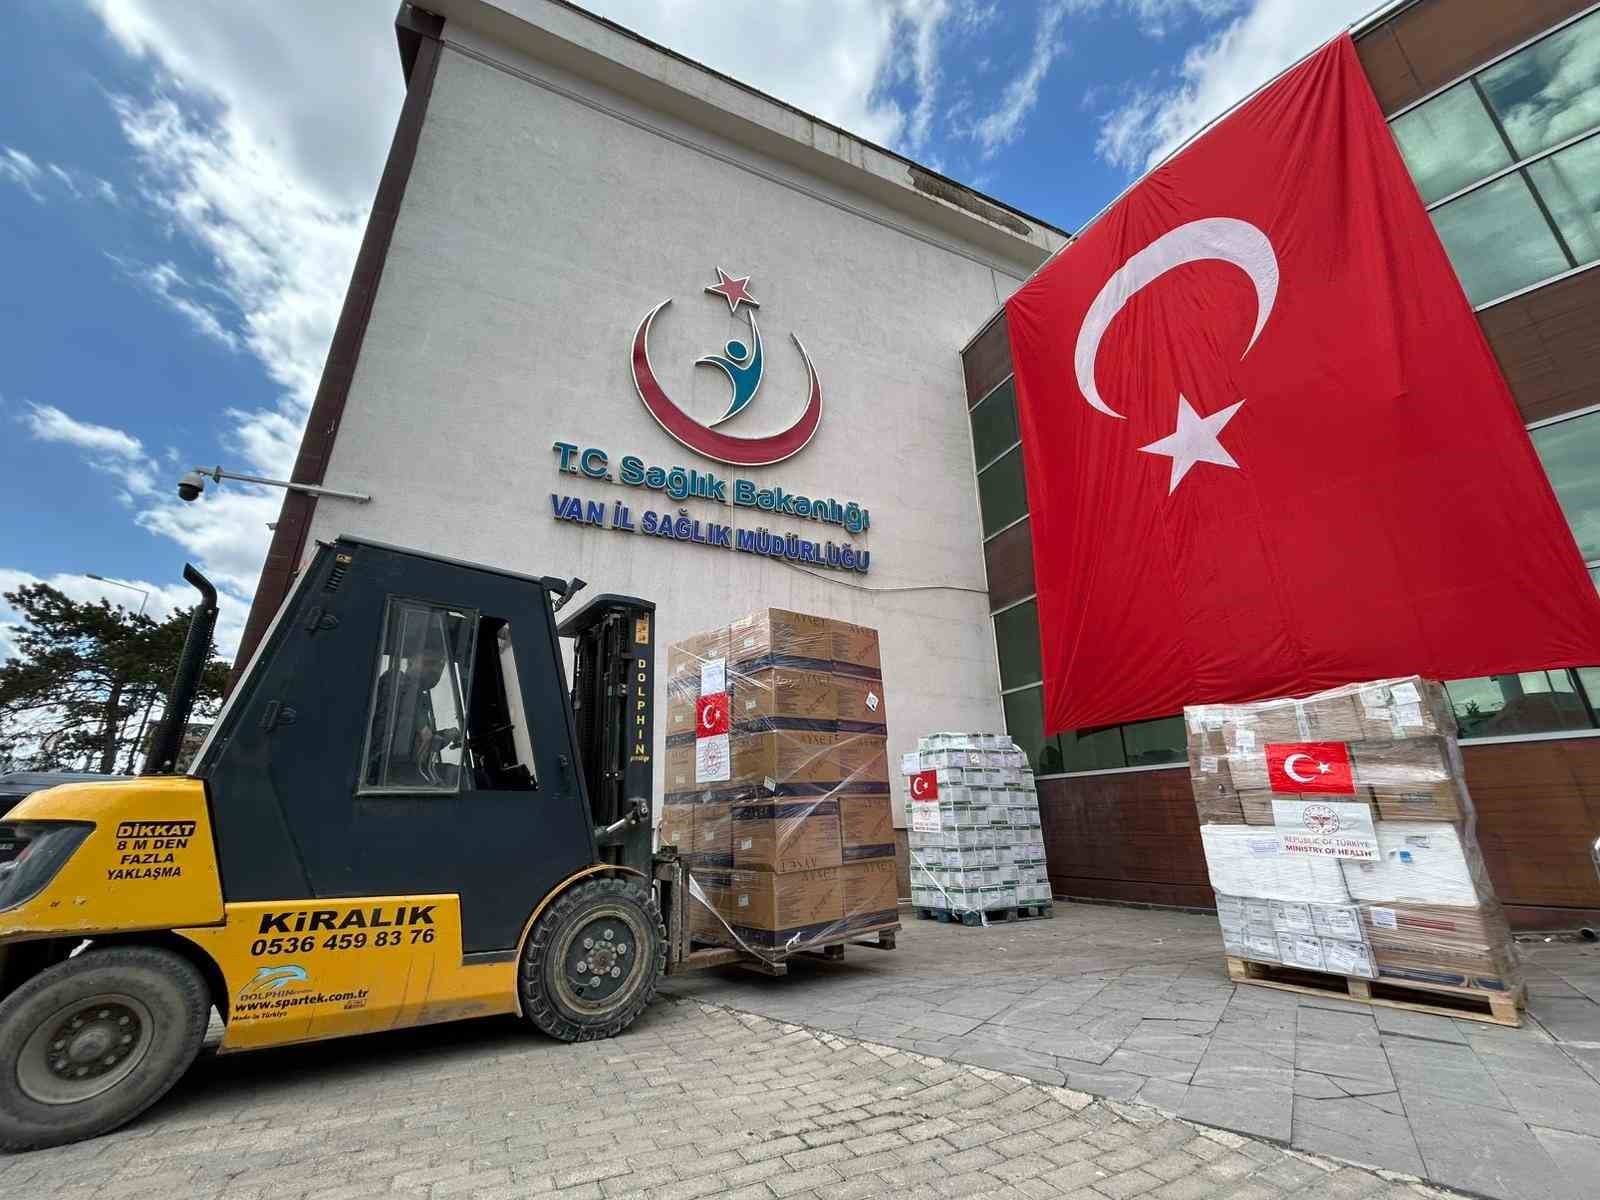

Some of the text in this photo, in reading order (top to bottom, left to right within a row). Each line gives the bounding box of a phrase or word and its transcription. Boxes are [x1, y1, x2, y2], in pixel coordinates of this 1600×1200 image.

[552, 441, 870, 535] T.C. Sağlık Bakanlığı
[551, 493, 606, 527] VAN
[612, 500, 635, 532] İL
[640, 506, 732, 549] SAĞLIK
[636, 659, 647, 755] DOLPHIN
[118, 823, 195, 837] DİKKAT
[117, 838, 188, 851] 8 M DEN
[1286, 844, 1323, 855] MINISTRY
[1324, 846, 1335, 856] OF
[1337, 848, 1372, 858] HEALTH
[120, 853, 174, 865] FAZLA
[107, 866, 181, 880] YAKLAŞMA
[250, 928, 435, 956] 0536 459 83 76
[235, 988, 368, 1012] www.spartek.com.tr
